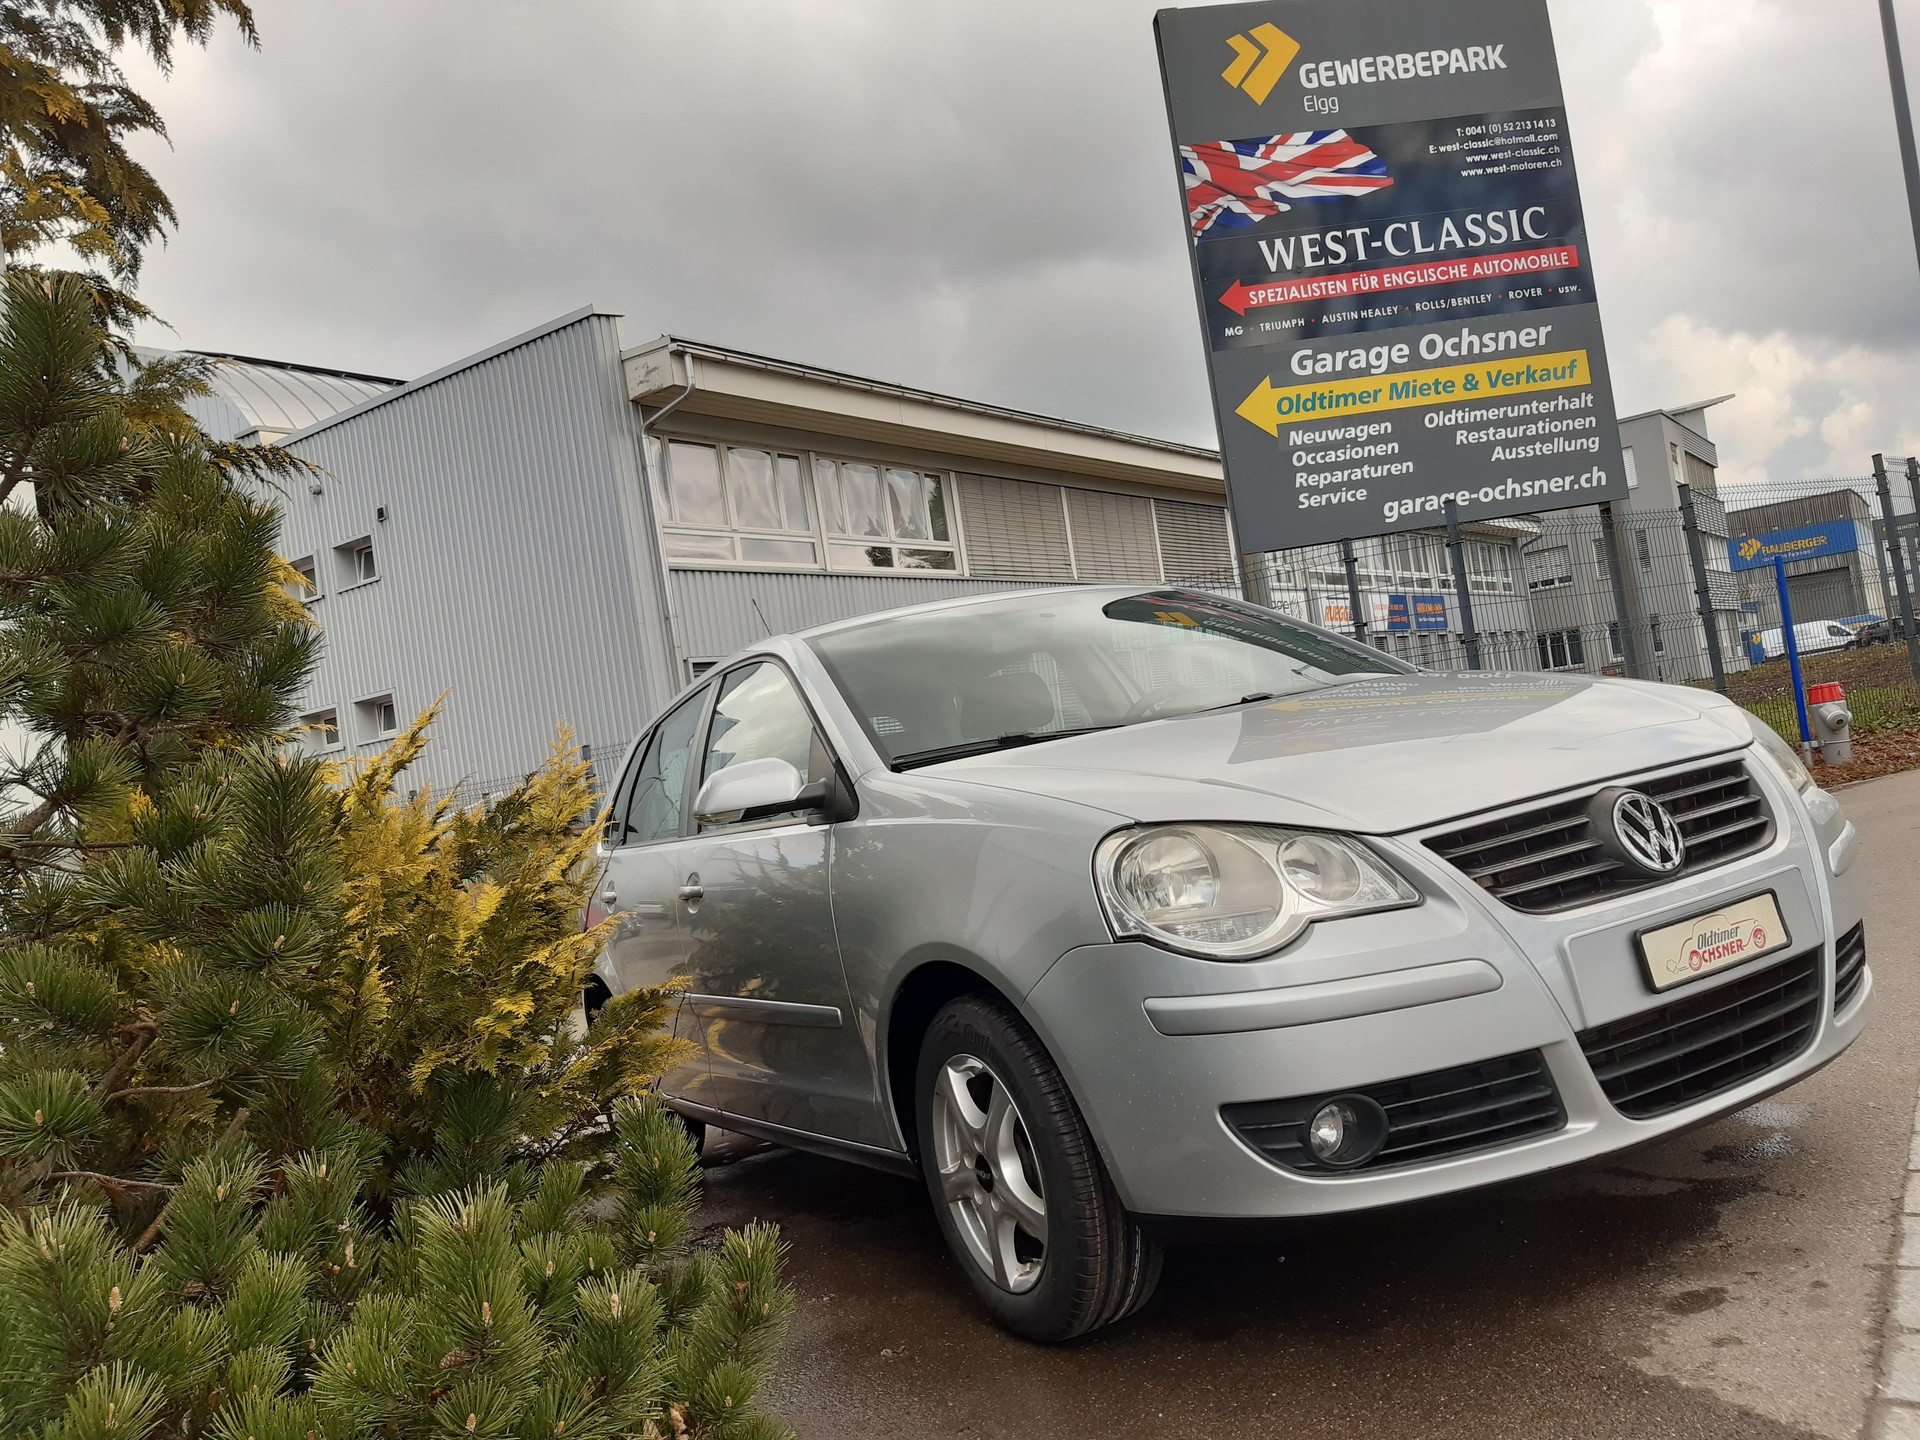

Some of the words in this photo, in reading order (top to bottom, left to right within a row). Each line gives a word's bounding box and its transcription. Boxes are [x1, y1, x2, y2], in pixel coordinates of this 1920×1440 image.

[1299, 44, 1507, 89] GEWERBEPARK
[1303, 95, 1339, 114] Elgg
[1429, 145, 1437, 153] E:
[1439, 133, 1558, 152] west-classic@hotmail.com
[1456, 128, 1464, 137] T:
[1466, 125, 1486, 136] 0041
[1489, 124, 1501, 134] (0)
[1461, 159, 1562, 177] www.west-motoren.ch
[1466, 145, 1560, 163] www.west-classic.ch
[1257, 207, 1549, 273] WEST-CLASSIC
[1249, 279, 1348, 305] SPEZIALISTEN
[1353, 272, 1380, 292] FÜR
[1383, 265, 1469, 288] ENGLISCHE
[1473, 251, 1569, 278] AUTOMOBILE
[1224, 326, 1244, 337] MG
[1259, 317, 1305, 332] TRIUMPH
[1321, 310, 1359, 324] AUSTIN
[1360, 305, 1399, 320] HEALEY
[1415, 293, 1493, 313] ROLLS/BENTLEY
[1508, 286, 1543, 299] ROVER
[1290, 341, 1410, 376] Garage
[1419, 322, 1552, 358] Ochsner
[1276, 386, 1383, 416] Oldtimer
[1388, 377, 1455, 401] Miete
[1463, 373, 1479, 392] &
[1486, 359, 1578, 389] Verkauf
[1424, 393, 1594, 429] Oldtimerunterhalt
[1289, 420, 1392, 447] Neuwagen
[1455, 415, 1597, 445] Restaurationen
[1292, 441, 1399, 468] Occasionen
[1491, 434, 1600, 462] Ausstellung
[1295, 460, 1414, 488] Reparaturen
[1298, 488, 1368, 509] Service
[1383, 467, 1607, 523] garage-ochsner.ch
[1697, 925, 1740, 950] Oldtimer
[1688, 938, 1745, 971] OCHSNER
